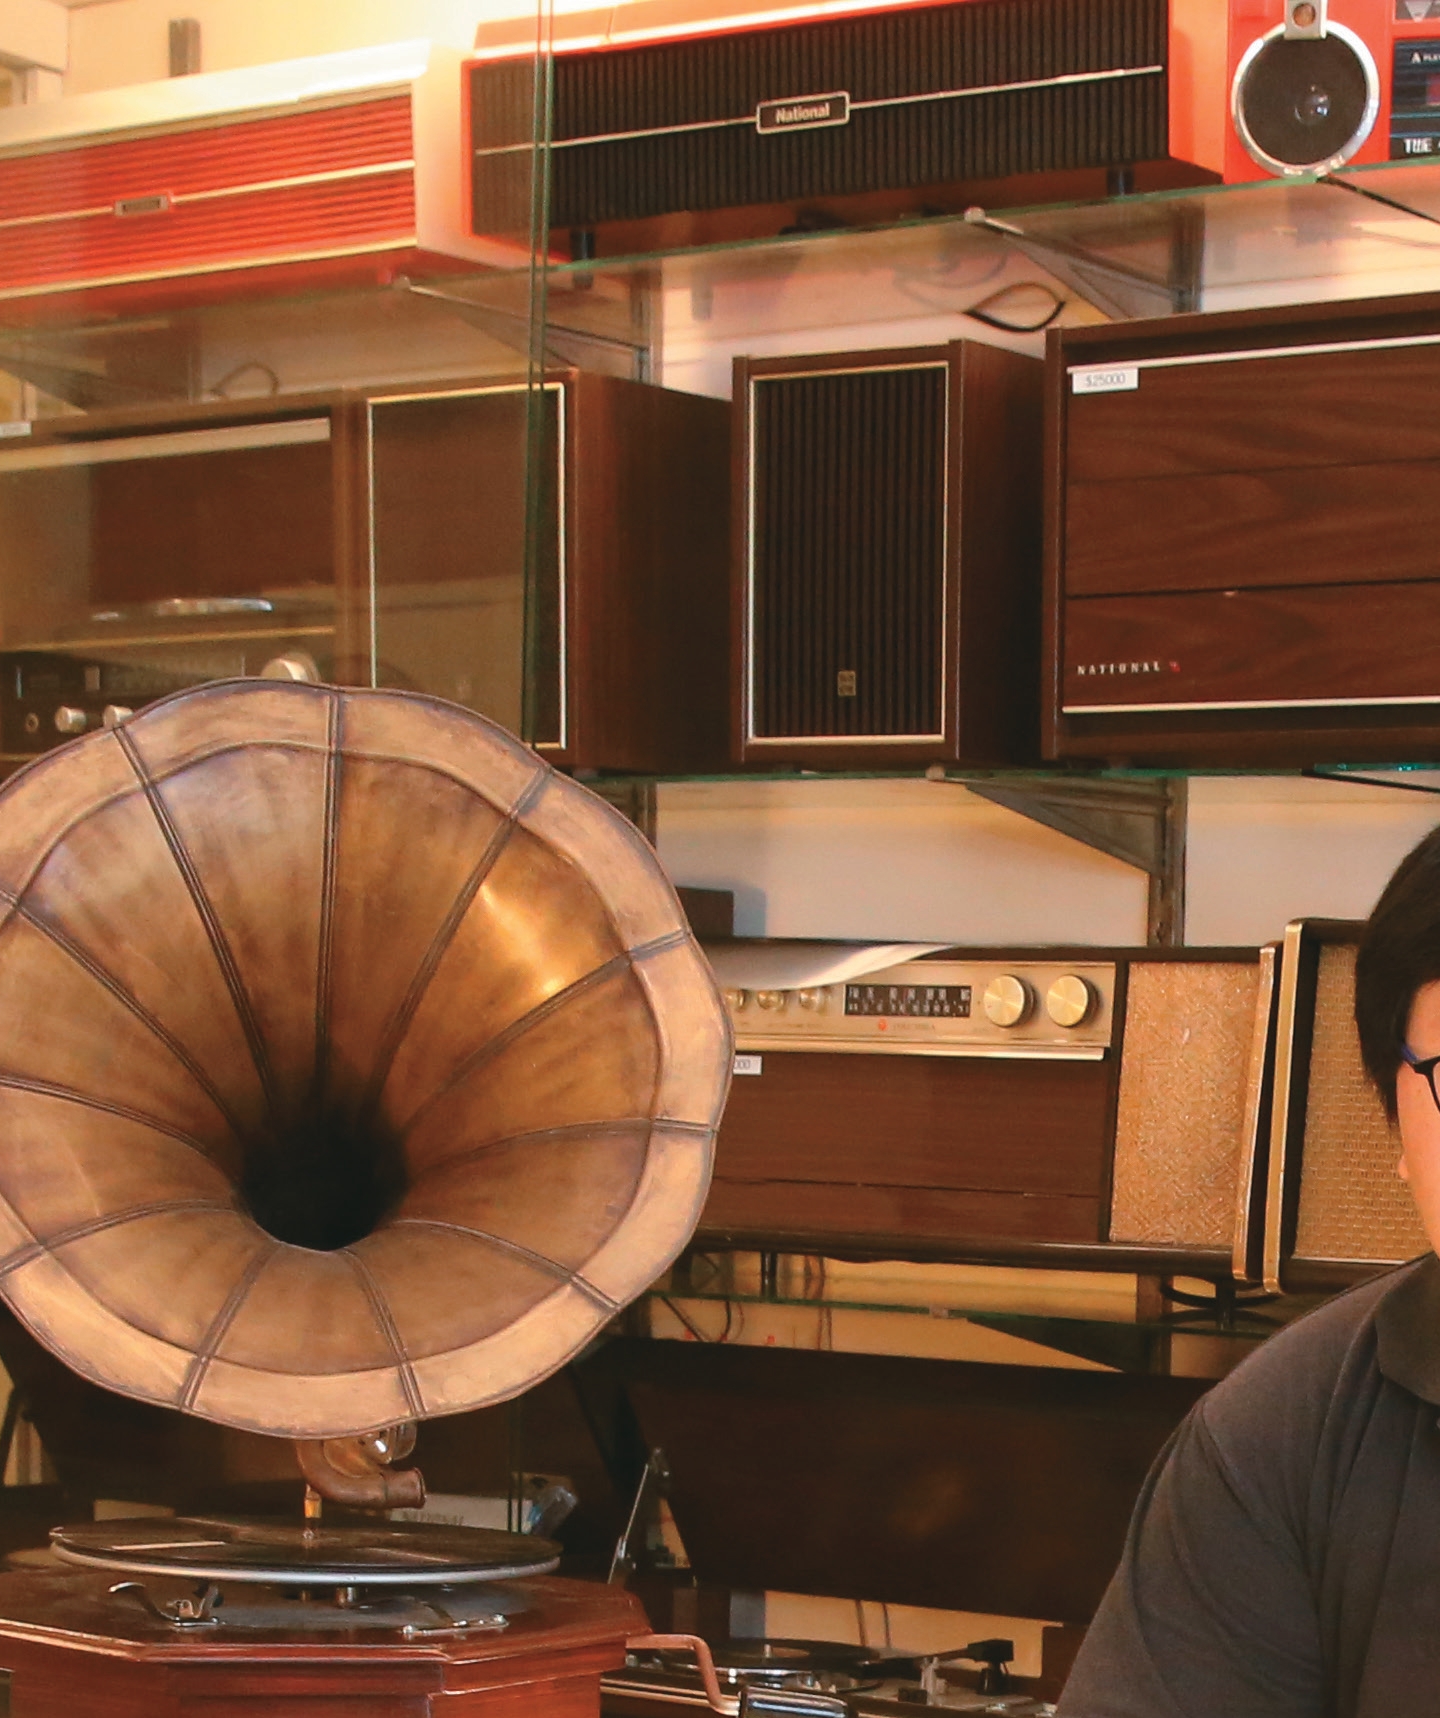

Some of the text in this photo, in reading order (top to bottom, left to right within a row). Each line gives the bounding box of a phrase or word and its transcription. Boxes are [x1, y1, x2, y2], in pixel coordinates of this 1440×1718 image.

[1410, 51, 1422, 63] A
[776, 102, 830, 124] National
[1086, 373, 1126, 387] $25000
[1077, 660, 1161, 676] NATIONAL
